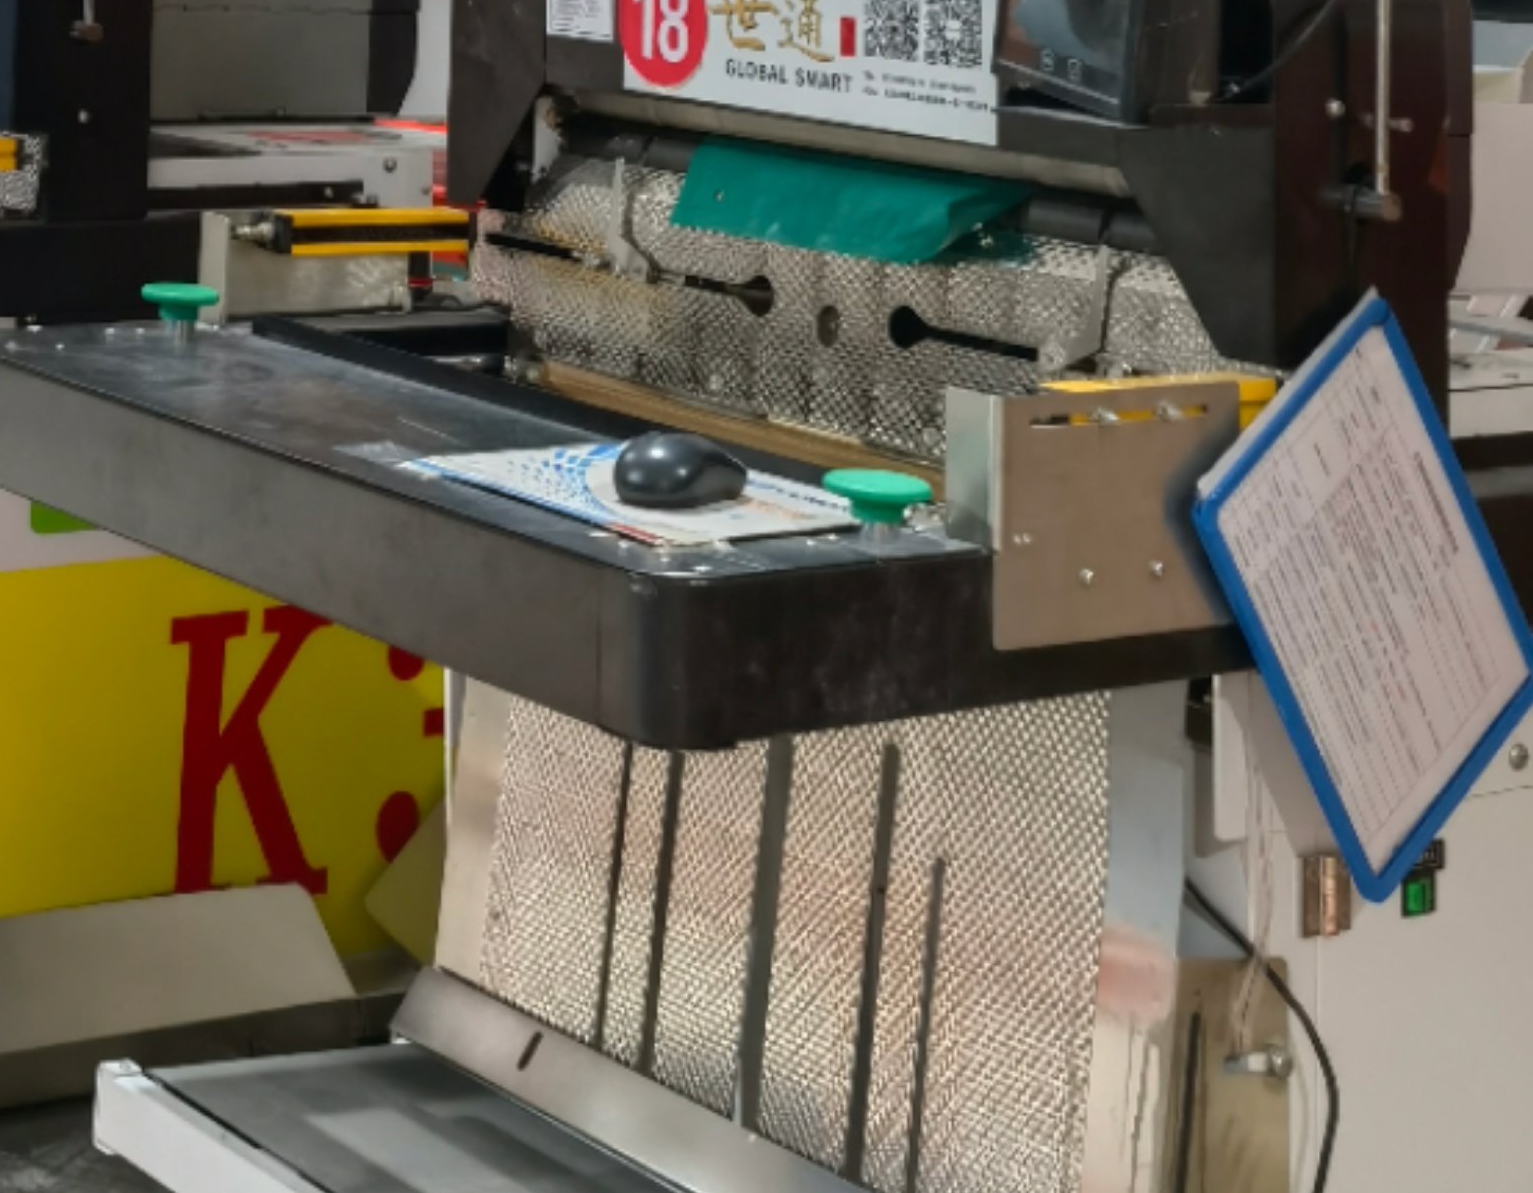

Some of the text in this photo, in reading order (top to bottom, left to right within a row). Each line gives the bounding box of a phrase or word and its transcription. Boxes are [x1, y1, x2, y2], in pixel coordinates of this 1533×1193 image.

[725, 57, 789, 85] GLOBAL
[795, 66, 853, 93] SMART
[170, 603, 445, 897] K
